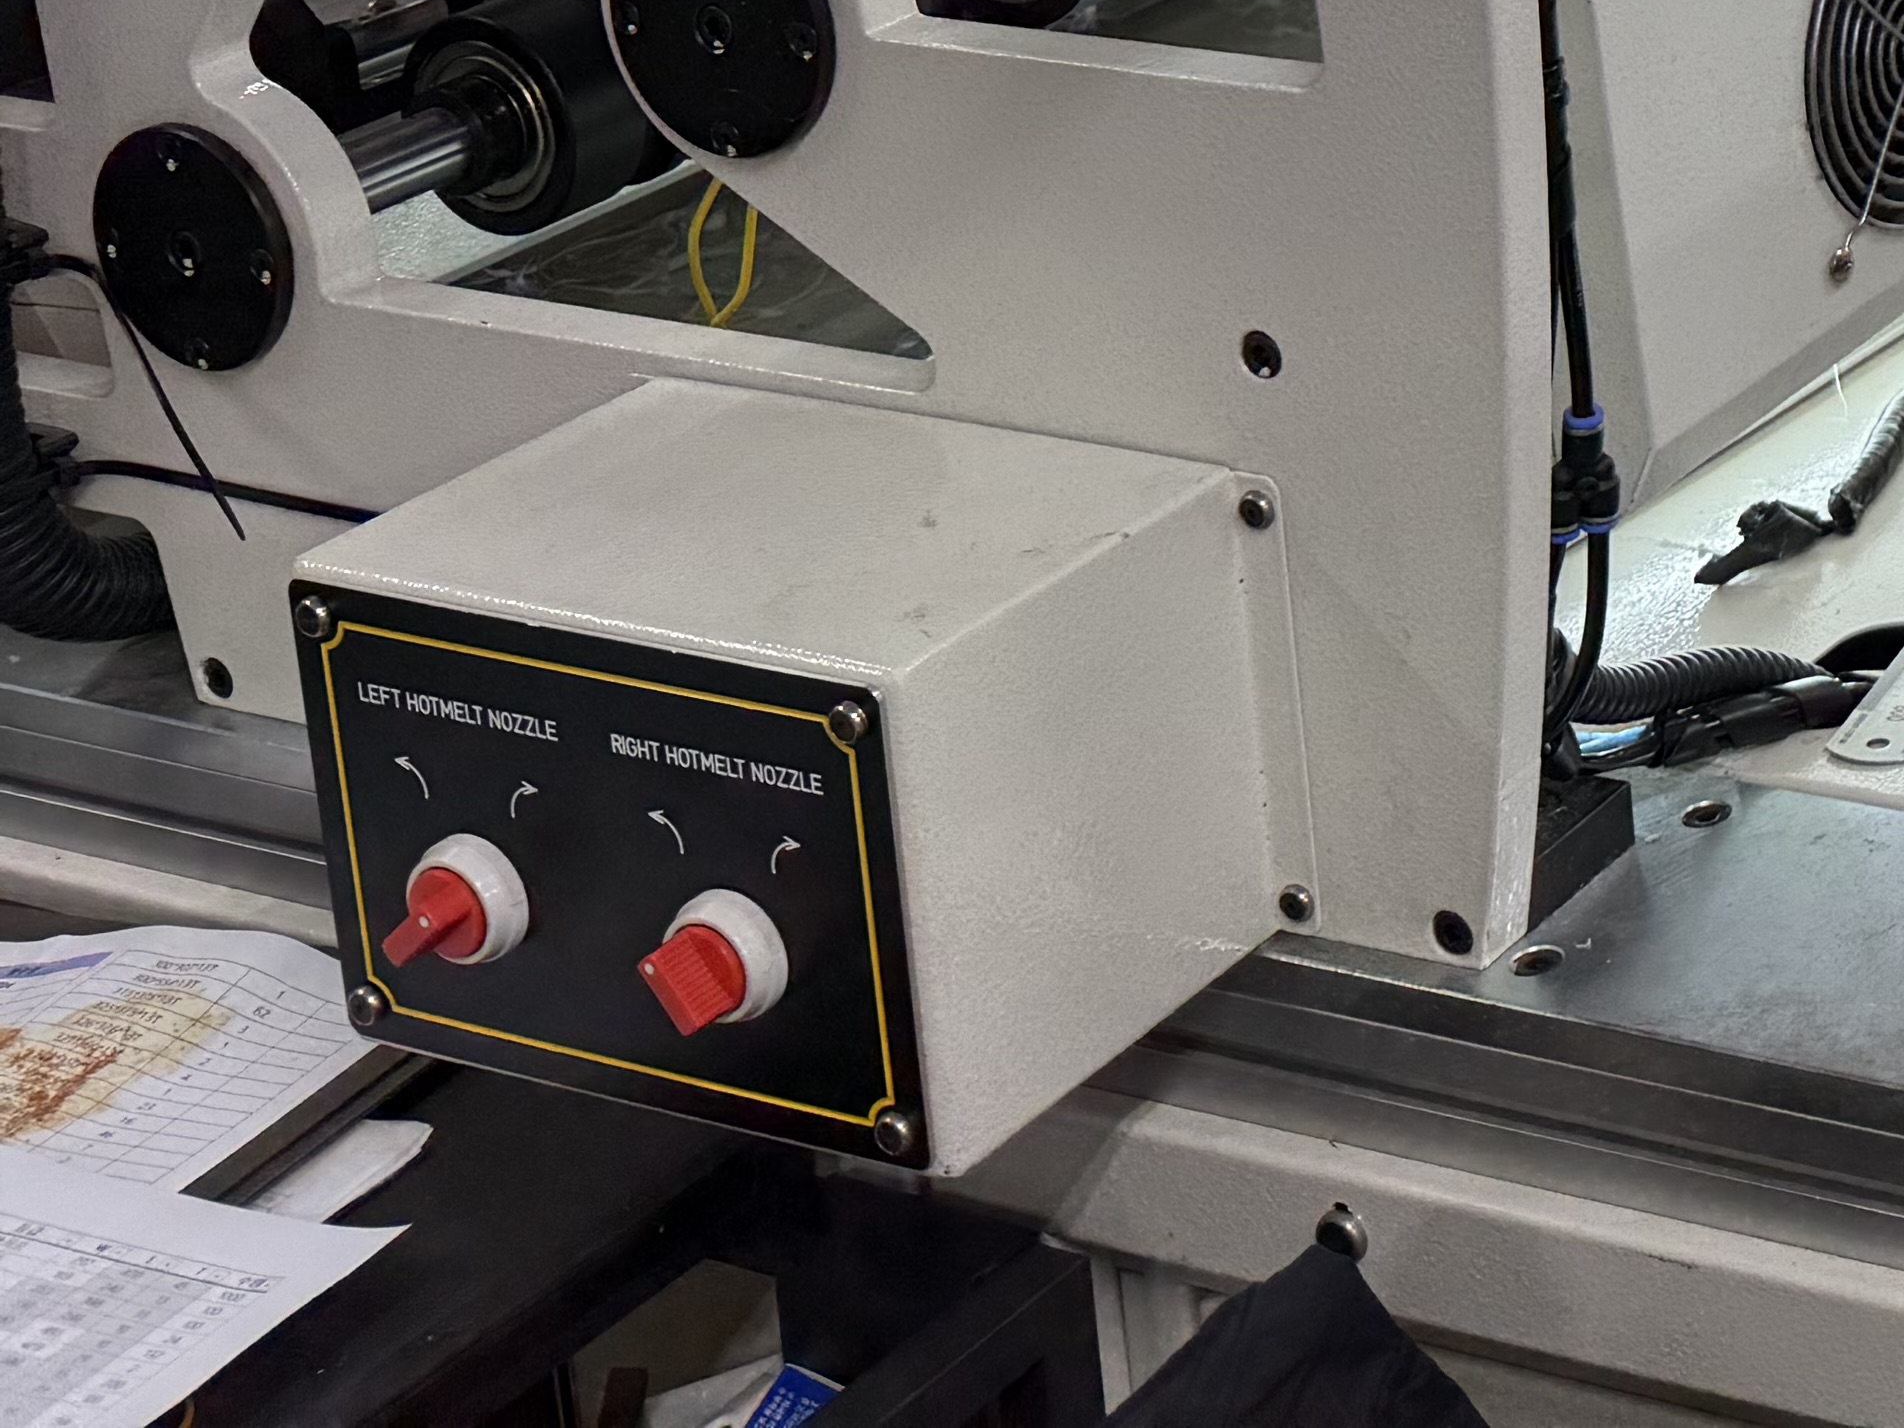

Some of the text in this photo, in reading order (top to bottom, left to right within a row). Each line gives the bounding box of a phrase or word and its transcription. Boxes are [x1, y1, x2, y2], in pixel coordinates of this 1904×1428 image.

[358, 680, 560, 742] LEFT HOTMELT NOZZLE
[610, 733, 825, 796] RIGHT HOTMELT NOZZLE
